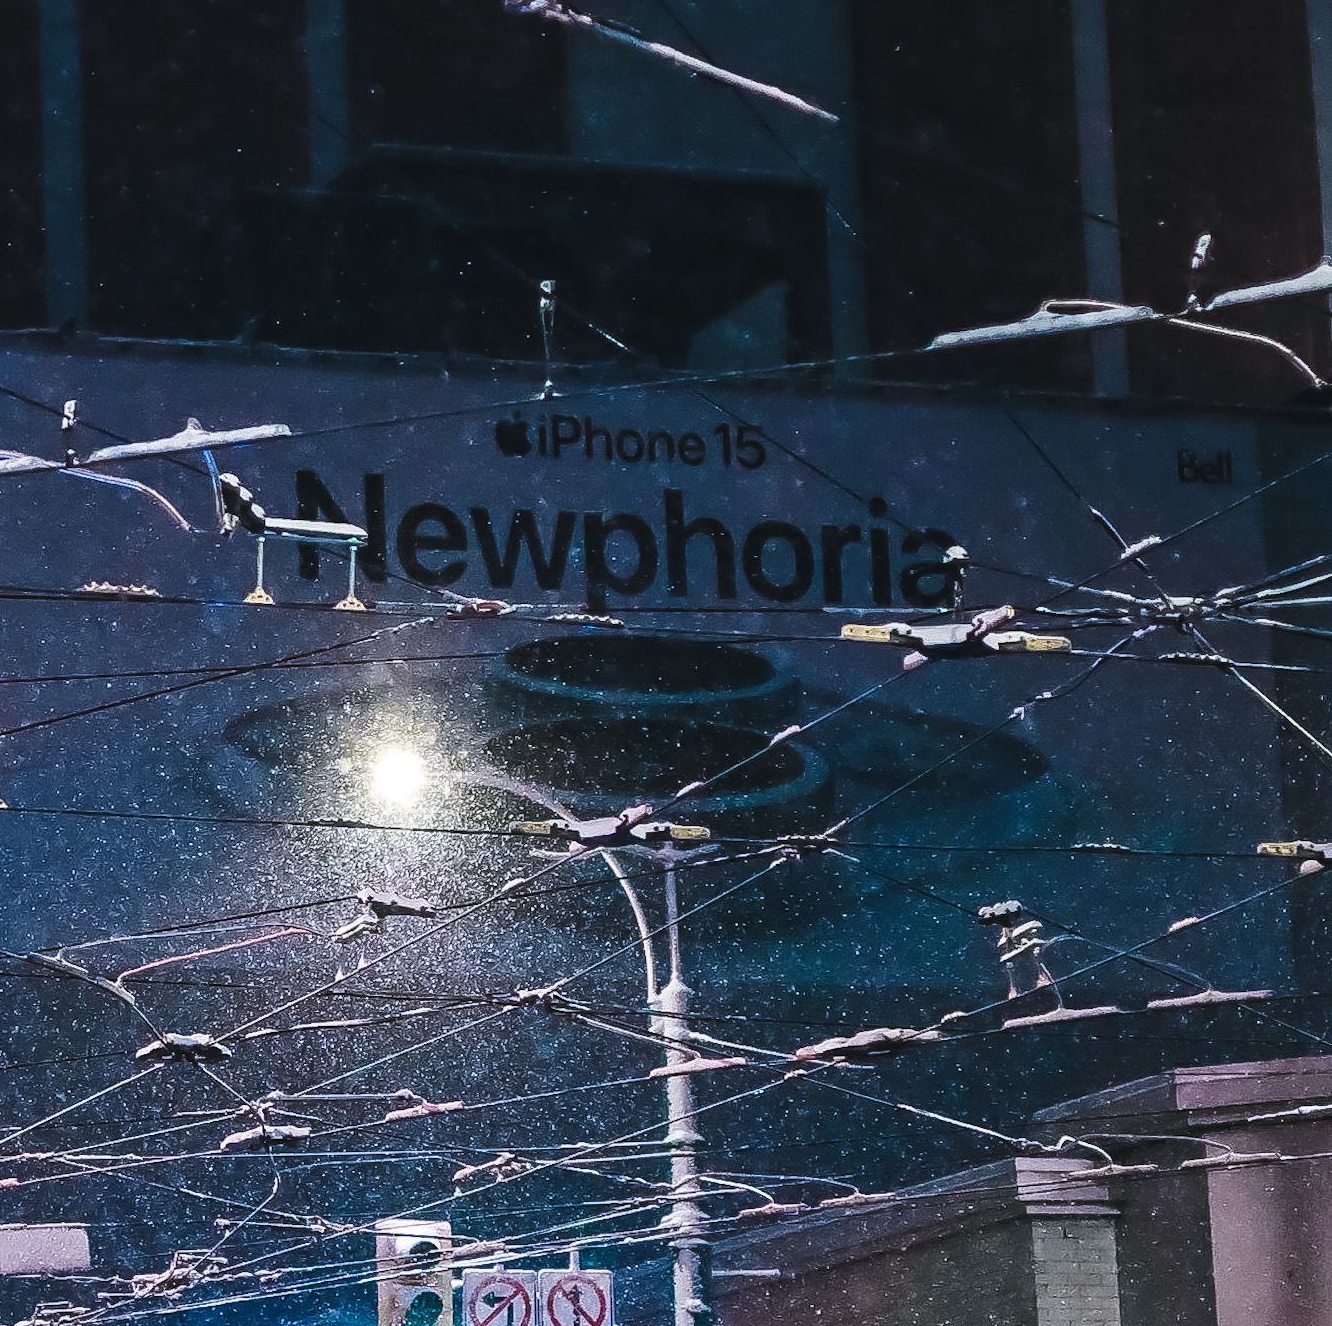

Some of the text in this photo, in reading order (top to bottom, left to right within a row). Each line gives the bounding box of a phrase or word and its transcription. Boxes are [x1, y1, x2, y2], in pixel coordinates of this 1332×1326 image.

[538, 415, 767, 470] iPhone 15
[1176, 450, 1233, 483] Bell
[295, 469, 960, 613] Newphoria
